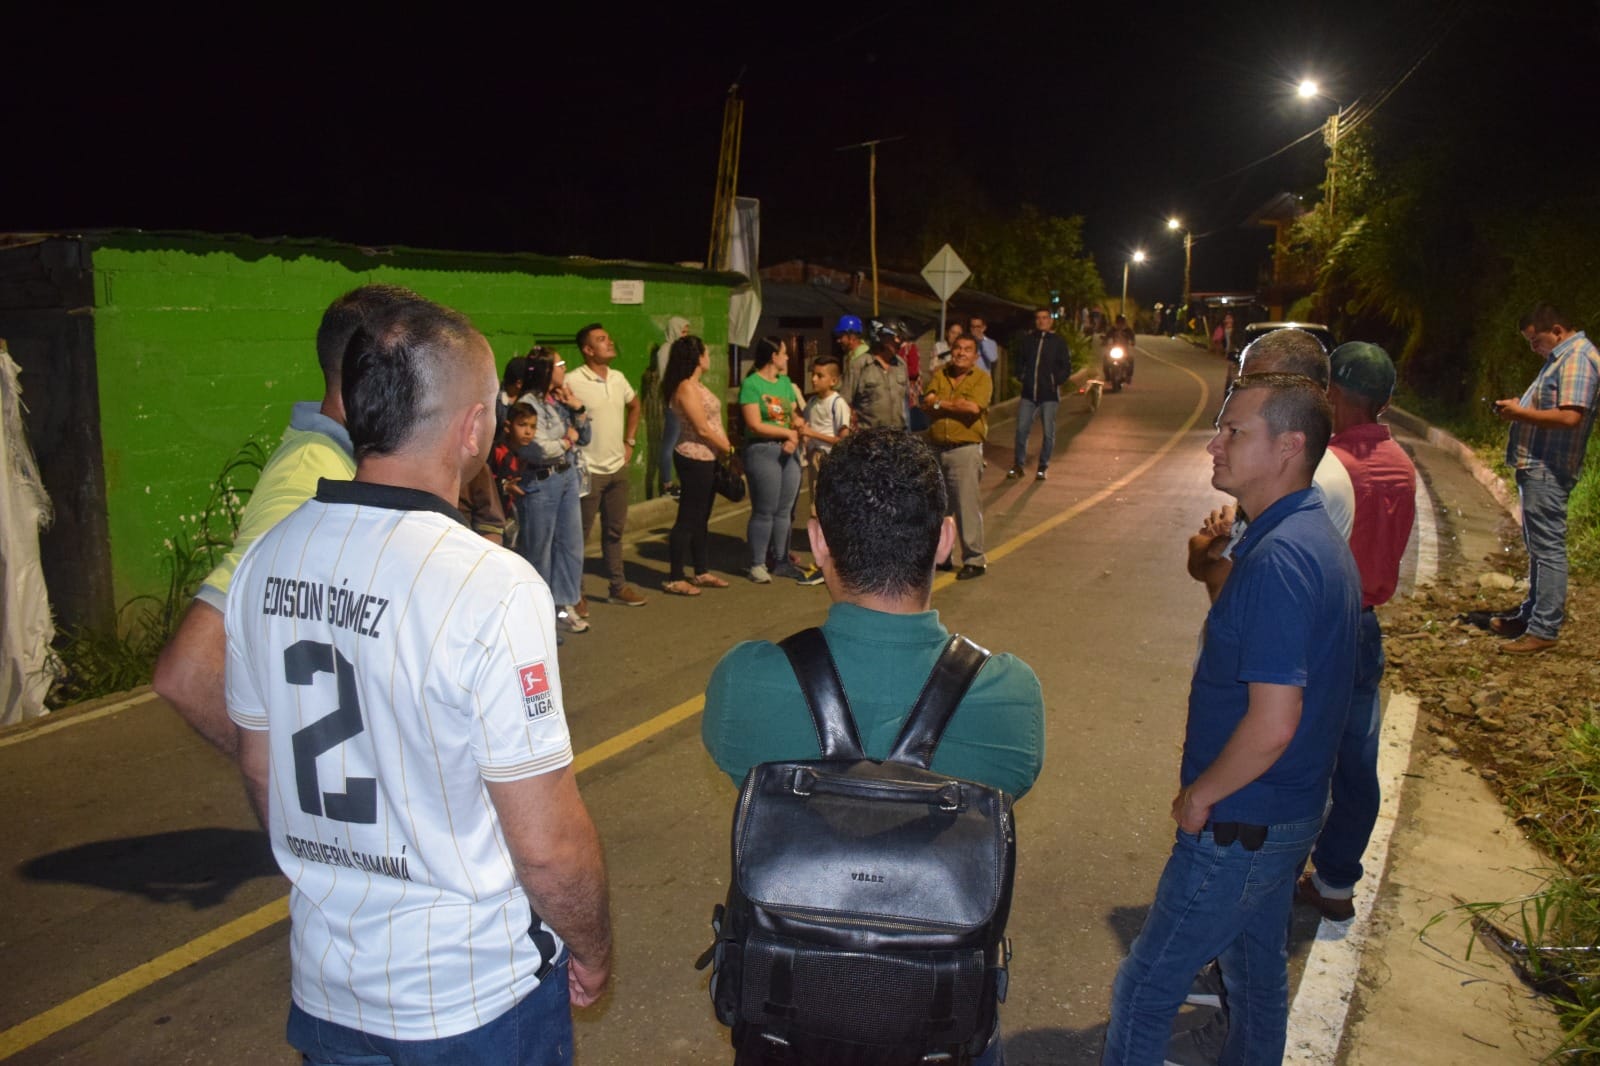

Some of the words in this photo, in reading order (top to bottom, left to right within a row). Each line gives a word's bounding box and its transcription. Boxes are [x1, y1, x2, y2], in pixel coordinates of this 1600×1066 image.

[263, 576, 323, 621] EDISON
[328, 578, 389, 639] GÓMEZ
[284, 640, 377, 824] 2
[527, 698, 554, 717] LIGA
